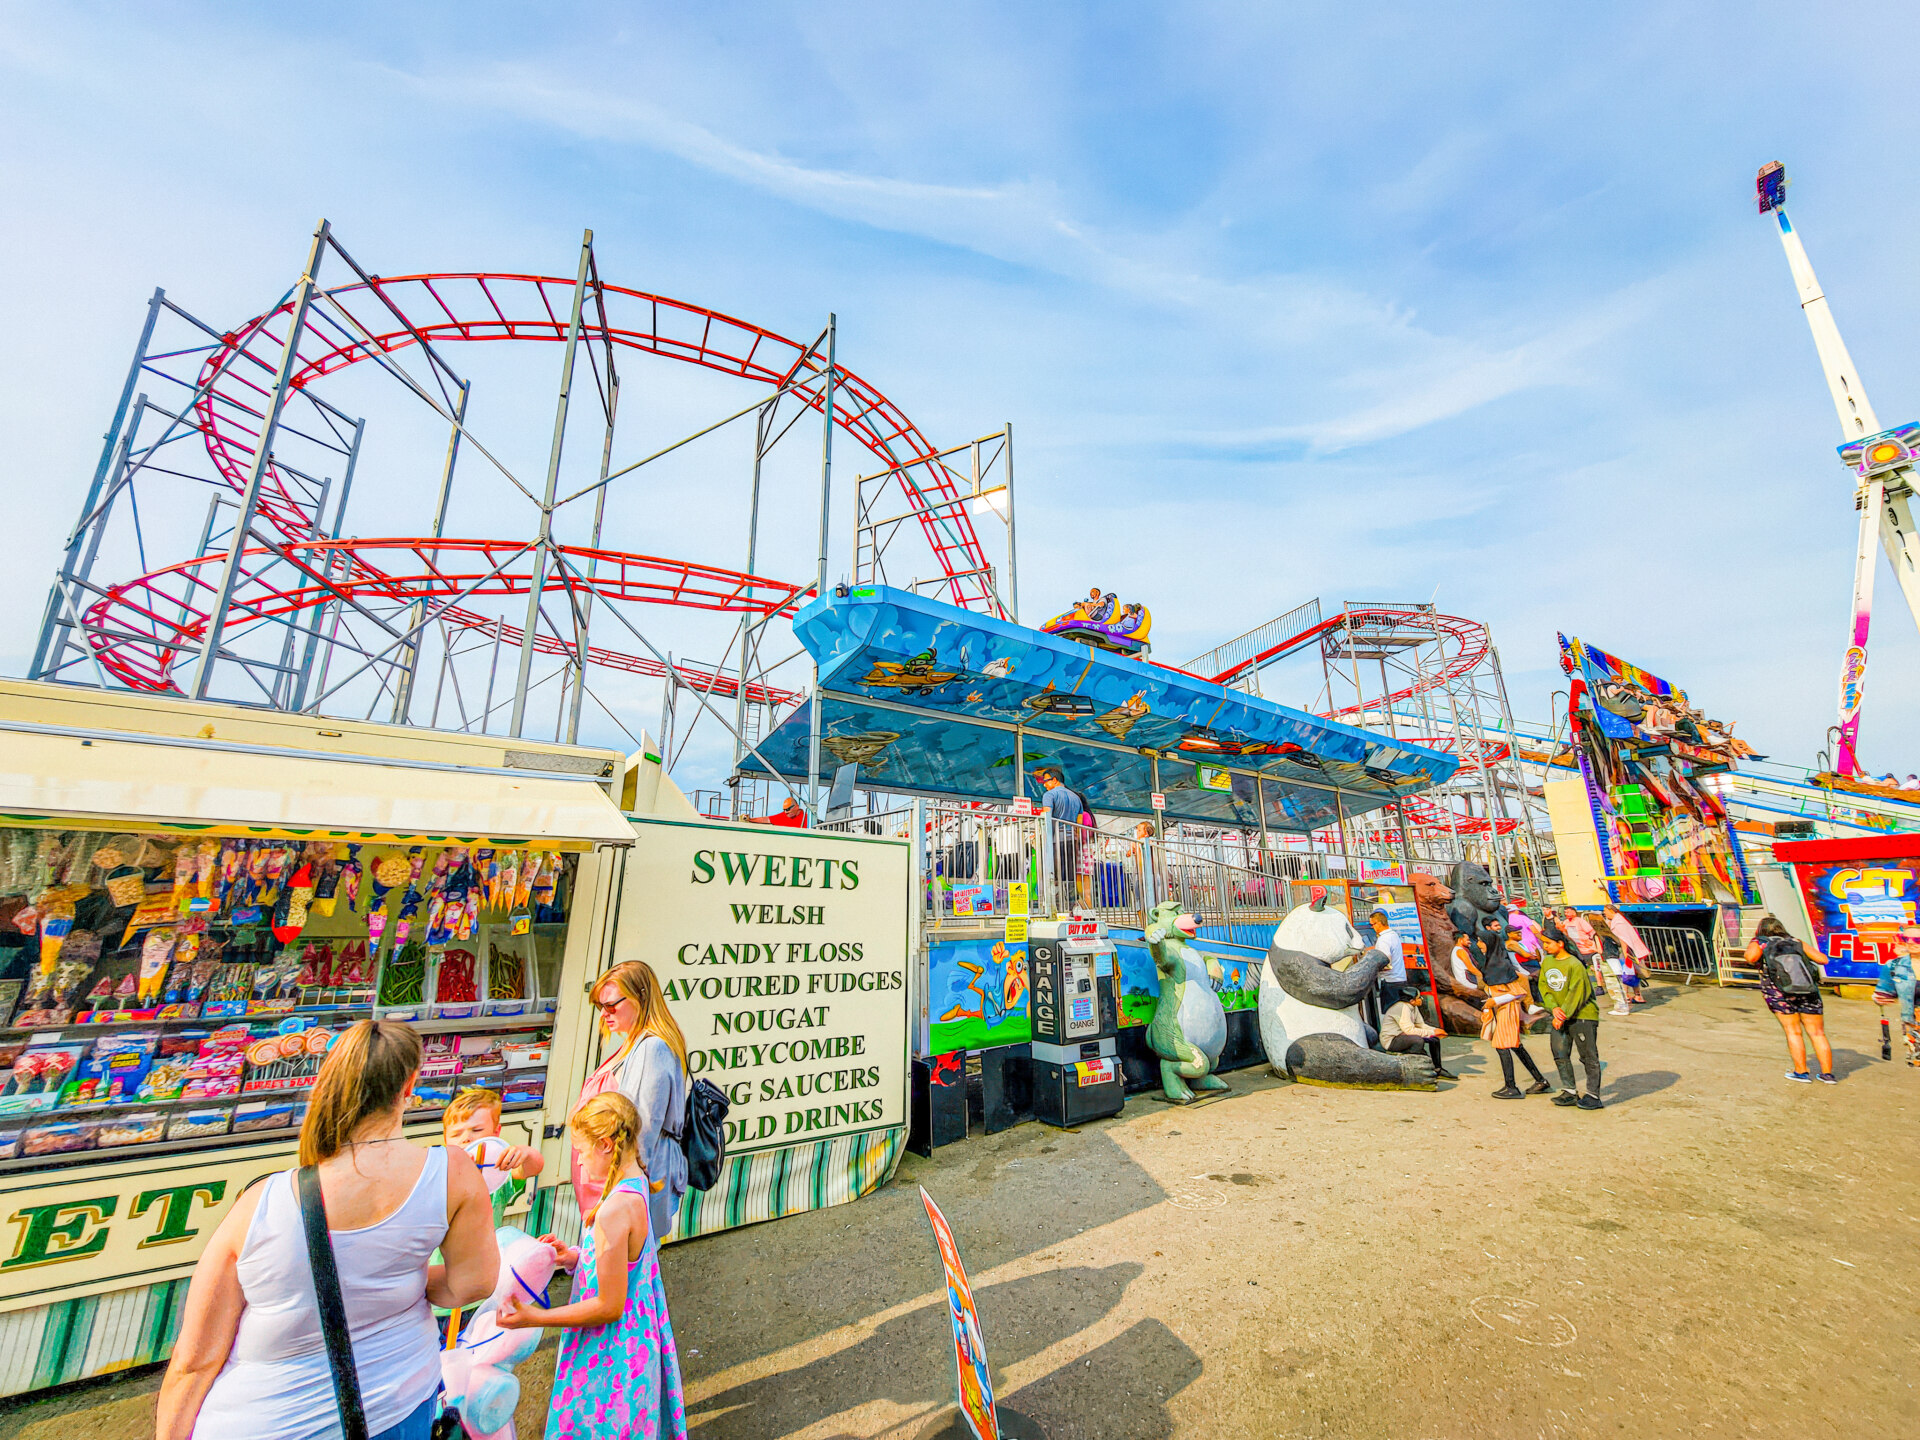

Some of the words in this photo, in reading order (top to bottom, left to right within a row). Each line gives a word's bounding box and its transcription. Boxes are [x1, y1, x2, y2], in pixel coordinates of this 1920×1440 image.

[690, 849, 859, 891] SWEETS
[1829, 867, 1914, 899] GET
[730, 903, 825, 925] WELSH
[1081, 922, 1098, 934] YOUR
[677, 943, 780, 966] CANDY
[786, 942, 864, 964] FLOSS
[1828, 933, 1897, 966] FEV
[662, 973, 800, 1002] AVOURED
[807, 971, 903, 995] FUDGES
[1034, 946, 1055, 1036] CHANGE
[711, 1006, 830, 1036] NOUGAT
[1069, 1019, 1095, 1030] CHANGE
[687, 1035, 866, 1075] ONEYCOMBE
[759, 1065, 880, 1102] SAUCERS
[722, 1115, 776, 1146] OLD
[784, 1098, 884, 1136] DRINKS
